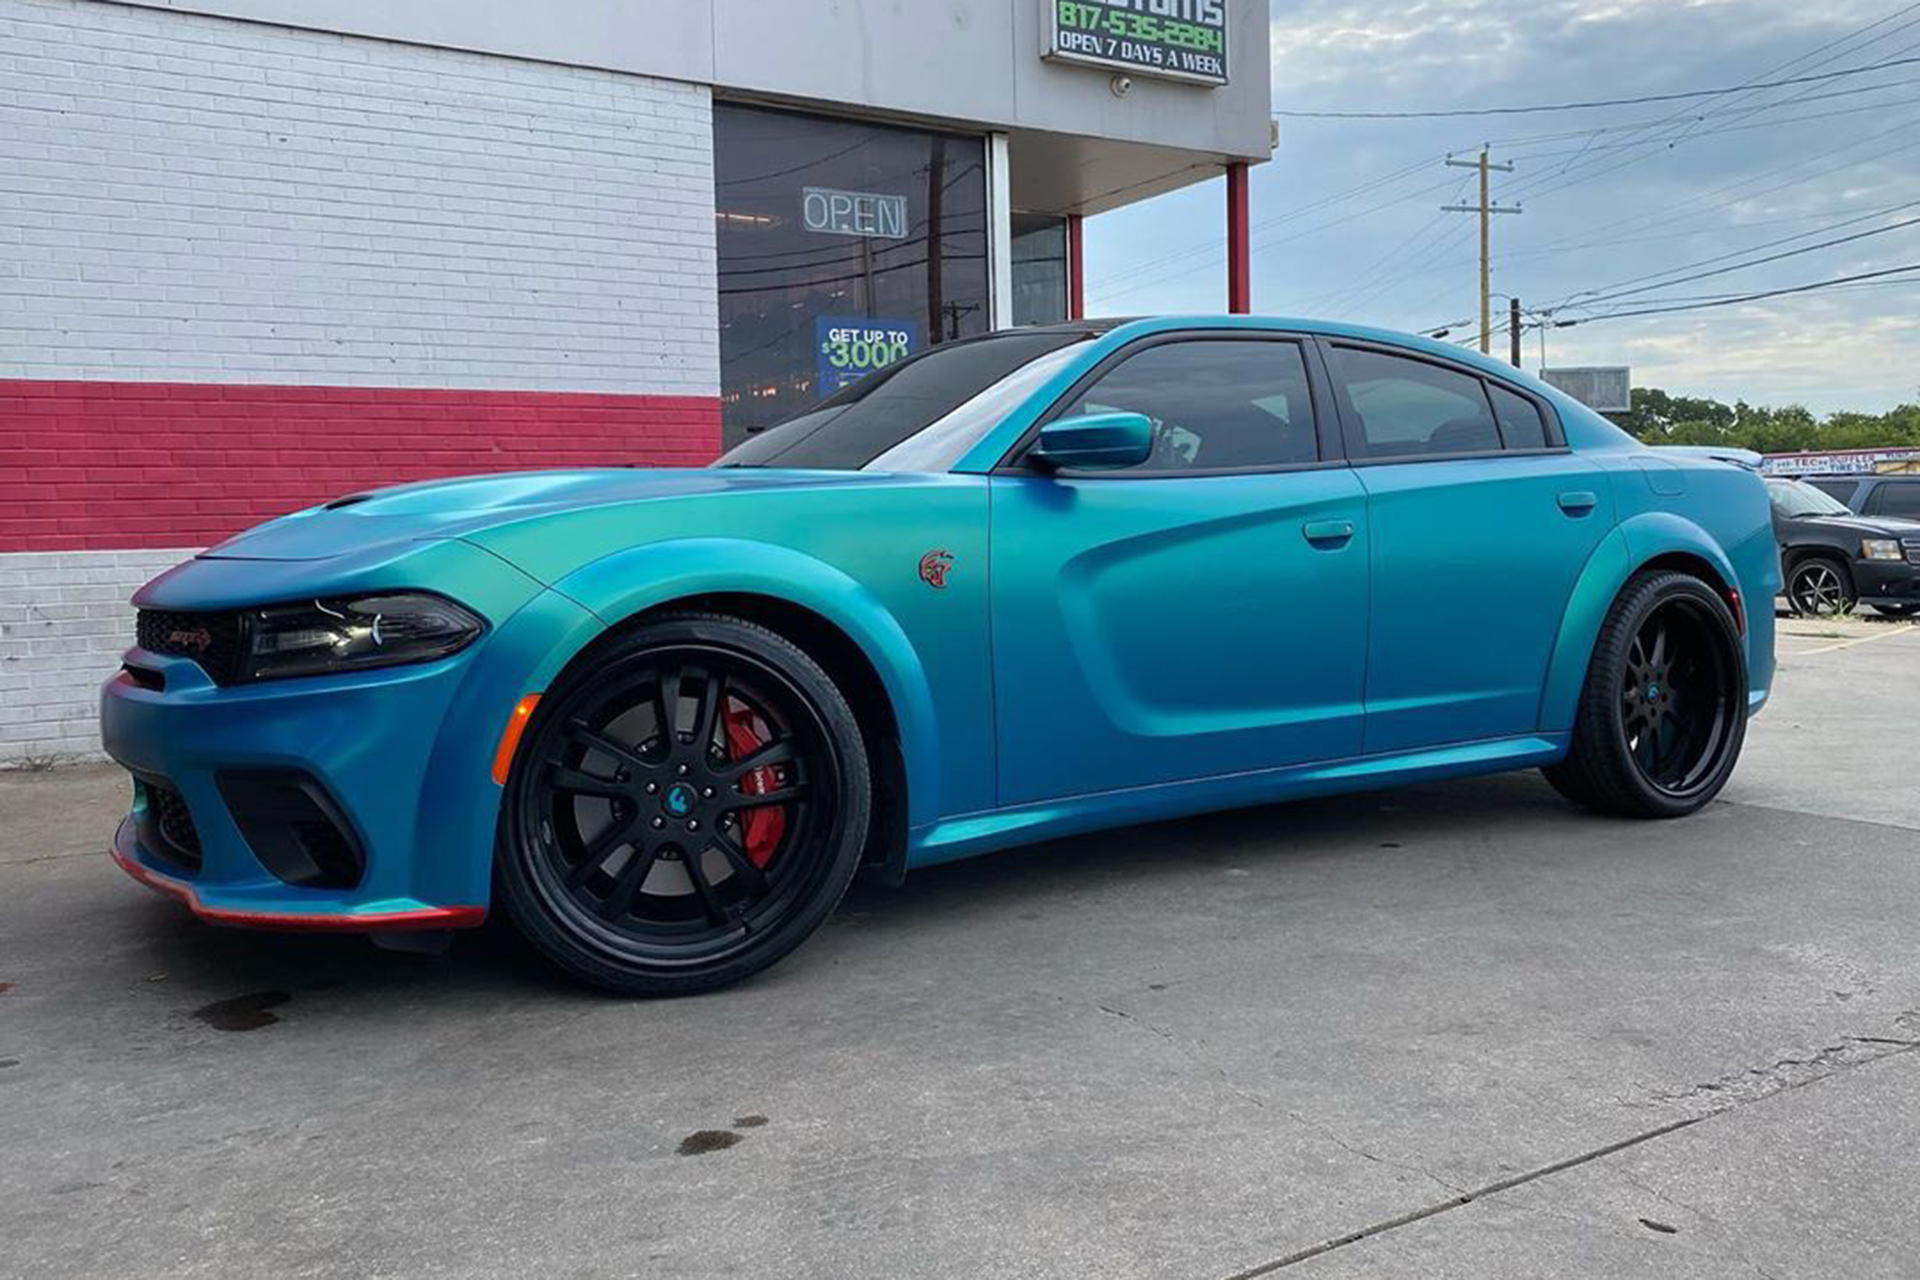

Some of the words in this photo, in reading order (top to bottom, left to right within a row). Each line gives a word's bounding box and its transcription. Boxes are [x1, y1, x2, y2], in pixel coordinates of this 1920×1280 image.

[1059, 1, 1223, 54] 817-535-2284
[1060, 31, 1103, 54] OPEN
[1106, 39, 1118, 56] 7
[1121, 41, 1163, 64] DAYS
[1166, 50, 1178, 67] A
[1182, 52, 1223, 75] WEEK
[804, 193, 900, 235] OPEN
[828, 328, 859, 342] GET
[863, 330, 884, 344] UP
[888, 331, 908, 345] TO
